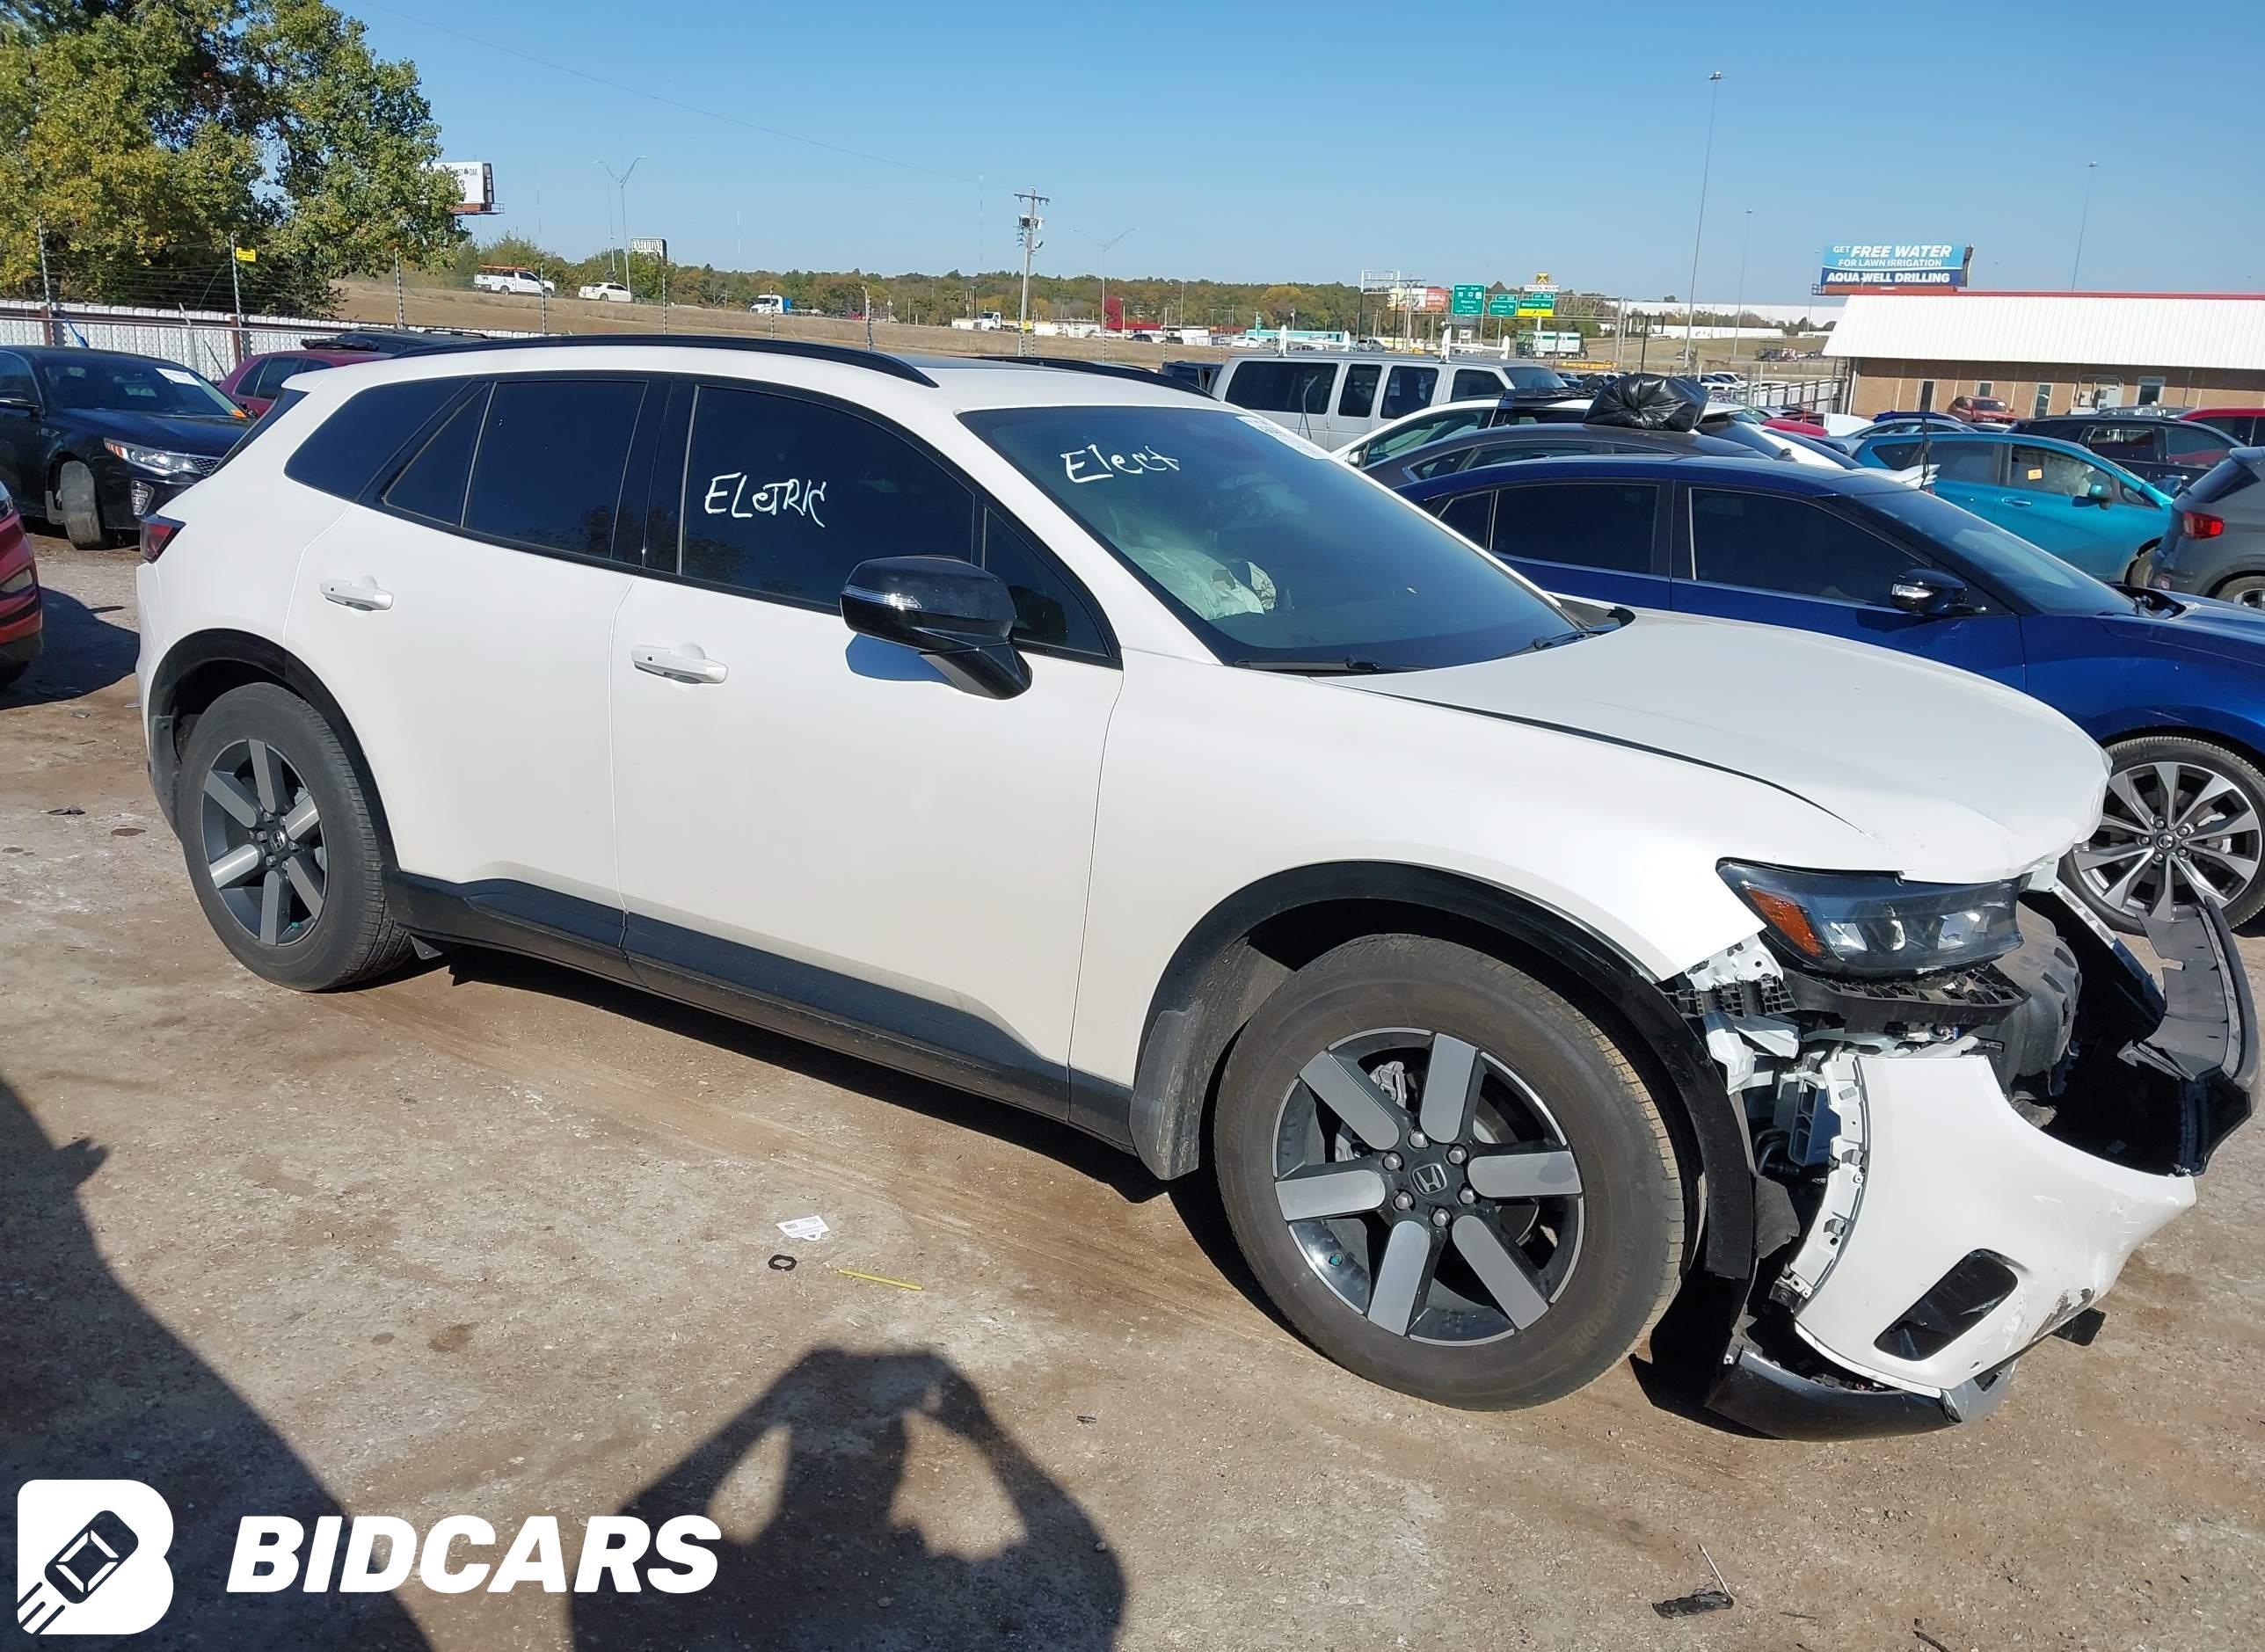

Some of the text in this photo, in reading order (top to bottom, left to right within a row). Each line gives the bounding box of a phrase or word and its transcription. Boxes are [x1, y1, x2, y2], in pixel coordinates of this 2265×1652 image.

[1832, 244, 1953, 258] GET FREE WATER
[1839, 258, 1942, 267] FOR LAWN IRRIGATION
[1826, 273, 1950, 283] AQUA WELL DRILLING
